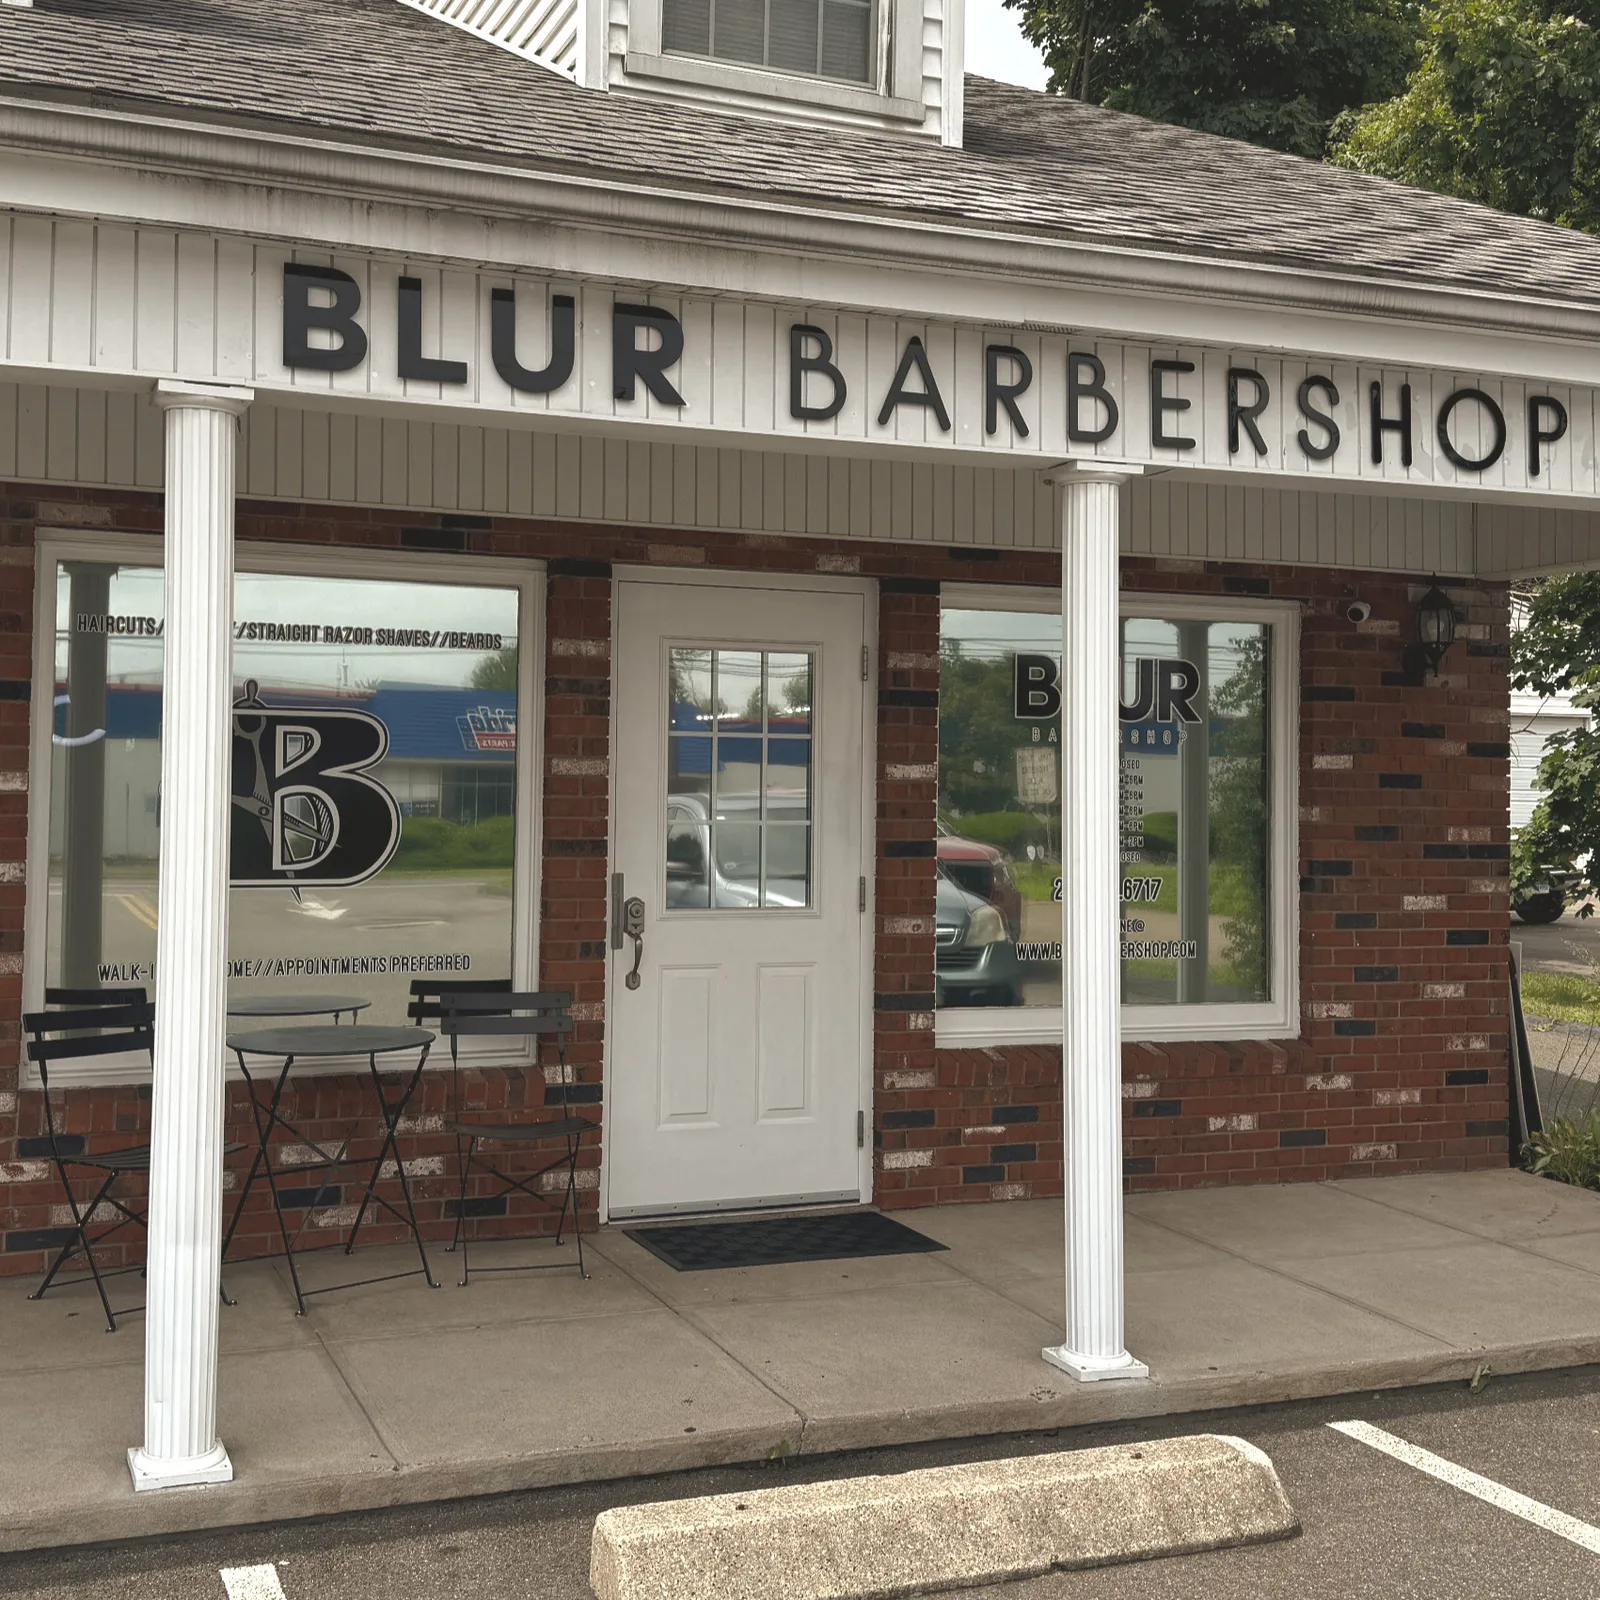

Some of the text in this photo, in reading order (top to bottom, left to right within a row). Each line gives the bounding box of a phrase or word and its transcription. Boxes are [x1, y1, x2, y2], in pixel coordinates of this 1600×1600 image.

[283, 262, 1568, 477] BLUR BARBERSHOP
[323, 625, 373, 645] RAZOR
[1015, 653, 1203, 723] BUR
[1120, 758, 1141, 770] OSED
[1120, 851, 1141, 863] OSED
[390, 953, 472, 974] PREFERRED
